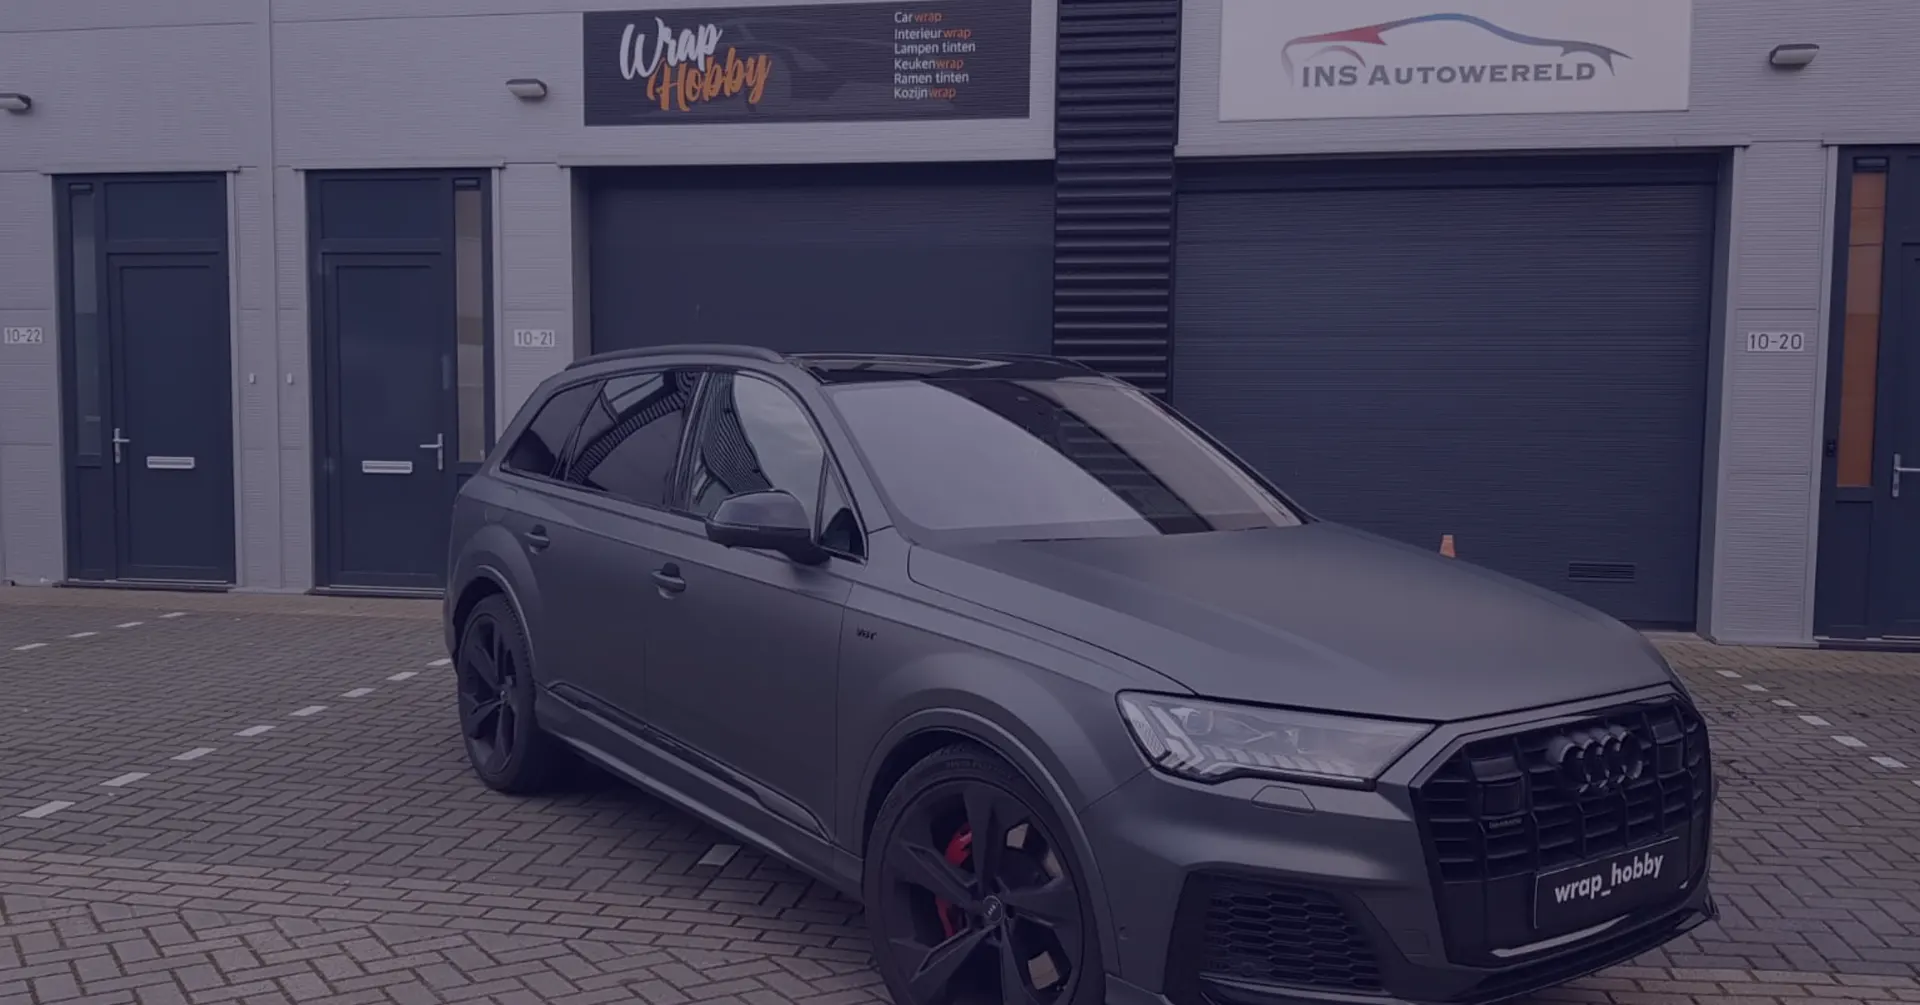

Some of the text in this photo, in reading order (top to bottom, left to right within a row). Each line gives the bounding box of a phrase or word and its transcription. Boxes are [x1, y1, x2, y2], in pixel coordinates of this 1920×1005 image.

[620, 16, 723, 80] Wrap
[894, 41, 976, 55] Lampen tinten
[647, 47, 772, 112] Hobby
[894, 71, 969, 84] Ramen tinten
[1302, 66, 1358, 88] INS
[7, 328, 41, 342] 10-22
[517, 331, 553, 345] 10-21
[1750, 333, 1802, 350] 10-20
[1555, 852, 1664, 903] wrap_hobby
